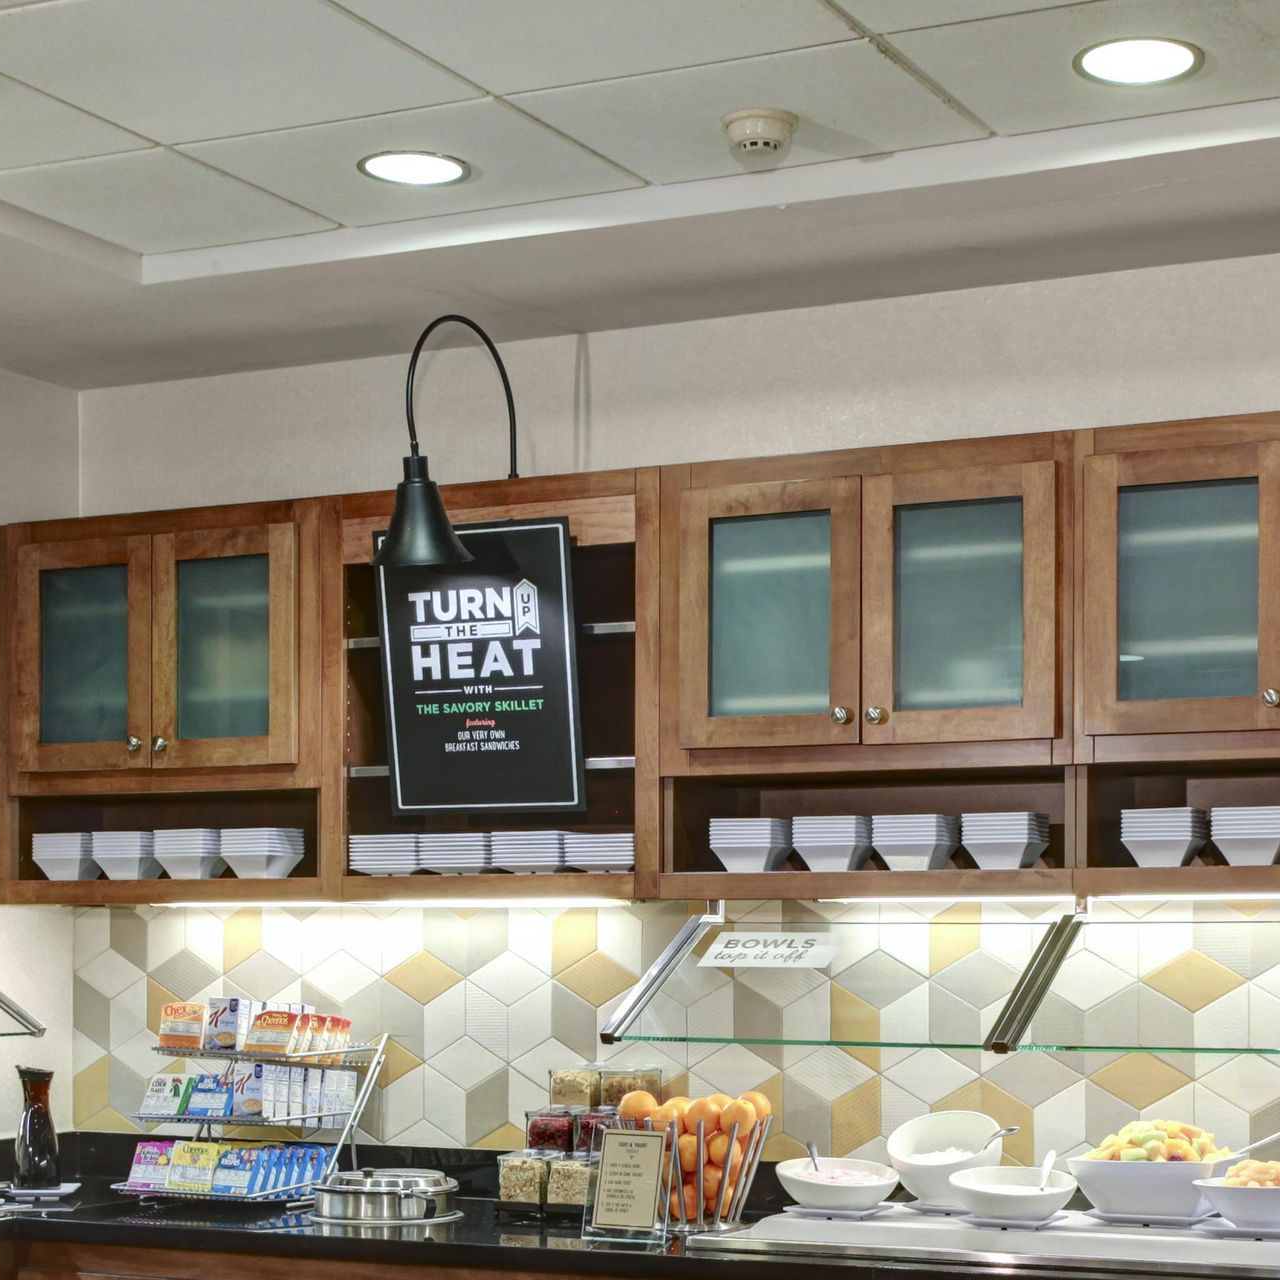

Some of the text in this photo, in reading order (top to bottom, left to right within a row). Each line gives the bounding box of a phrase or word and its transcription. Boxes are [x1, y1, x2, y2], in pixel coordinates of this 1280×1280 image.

[408, 586, 512, 622] TURN
[521, 593, 531, 616] UP
[445, 625, 478, 637] THE
[411, 639, 541, 680] HEAT
[464, 685, 493, 694] WITH
[416, 699, 544, 715] THE SAVORY SKILLET
[466, 718, 496, 728] featuring
[458, 730, 506, 740] OUR VERY OWN
[445, 741, 520, 752] BREAKFAST SANDWICHES
[723, 939, 817, 949] BOWLS
[754, 950, 769, 960] it
[164, 1005, 187, 1018] Chex
[208, 1006, 228, 1028] K
[261, 1015, 289, 1026] Cheerios
[235, 1073, 252, 1095] K
